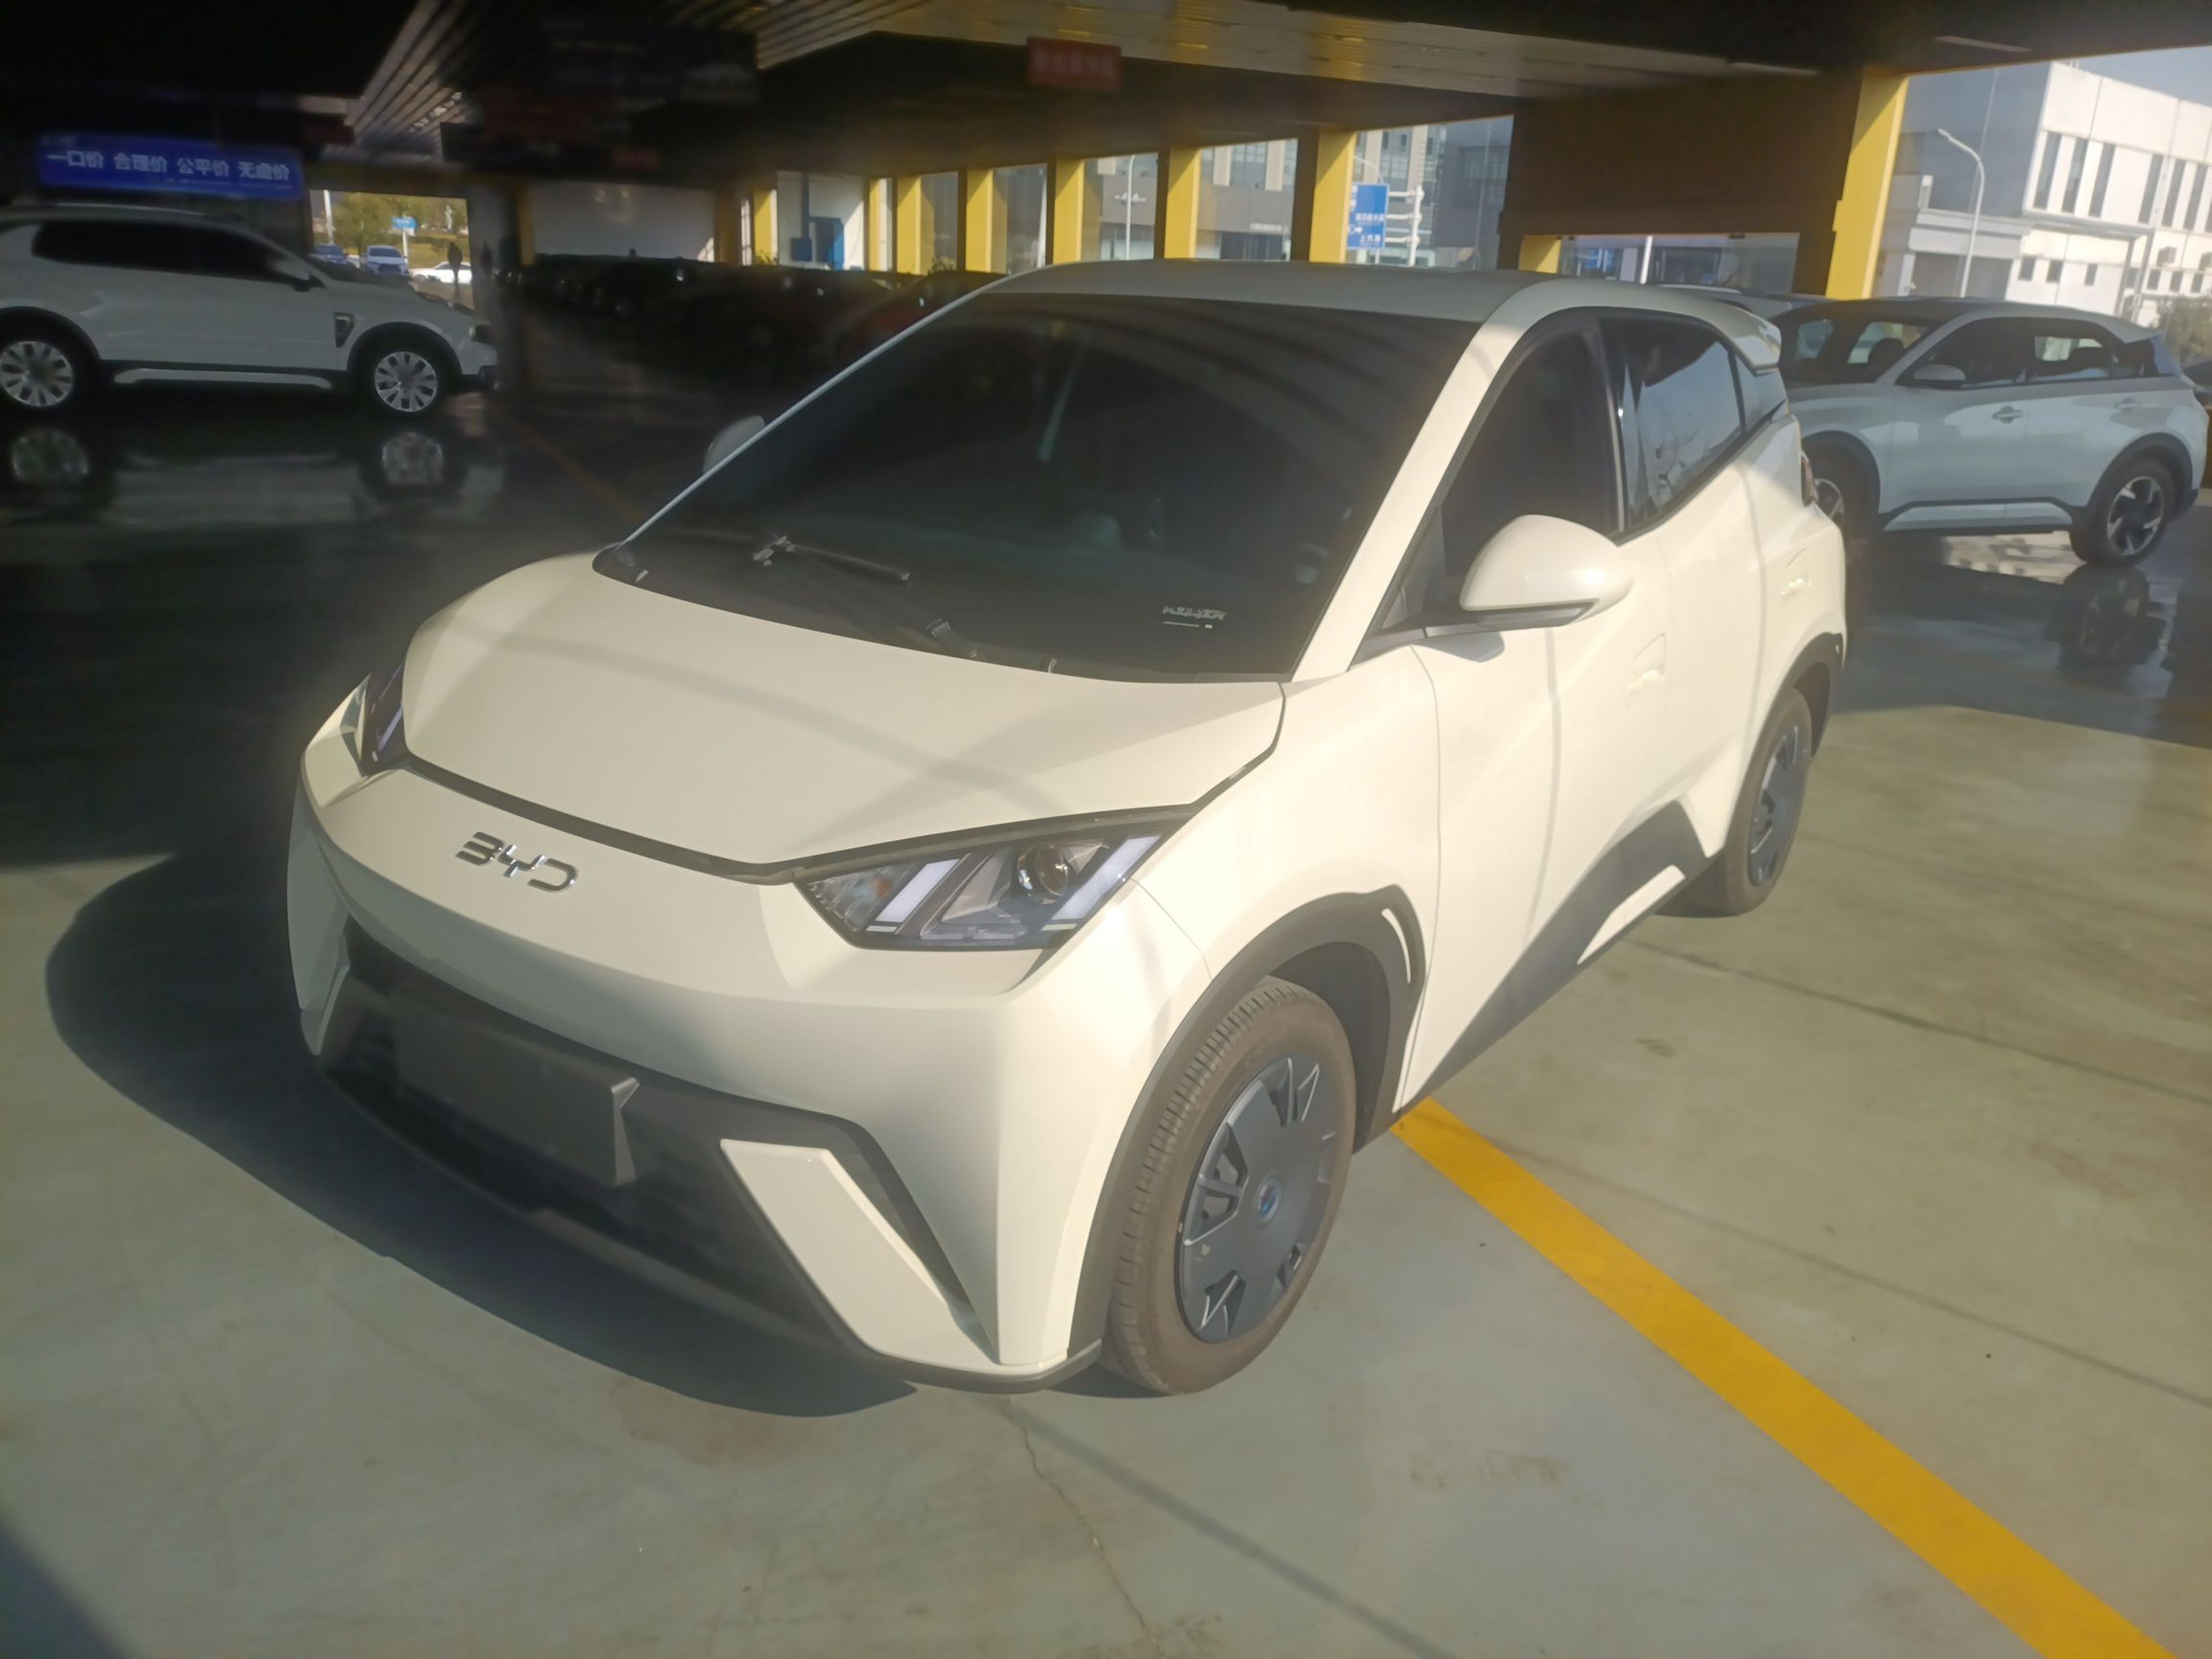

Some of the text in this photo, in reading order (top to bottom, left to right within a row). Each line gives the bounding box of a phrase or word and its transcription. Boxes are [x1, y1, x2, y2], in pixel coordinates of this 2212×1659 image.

[48, 150, 104, 169] 一口价
[114, 152, 167, 173] 合理价
[177, 157, 230, 177] 公平价
[455, 831, 577, 893] BYD
